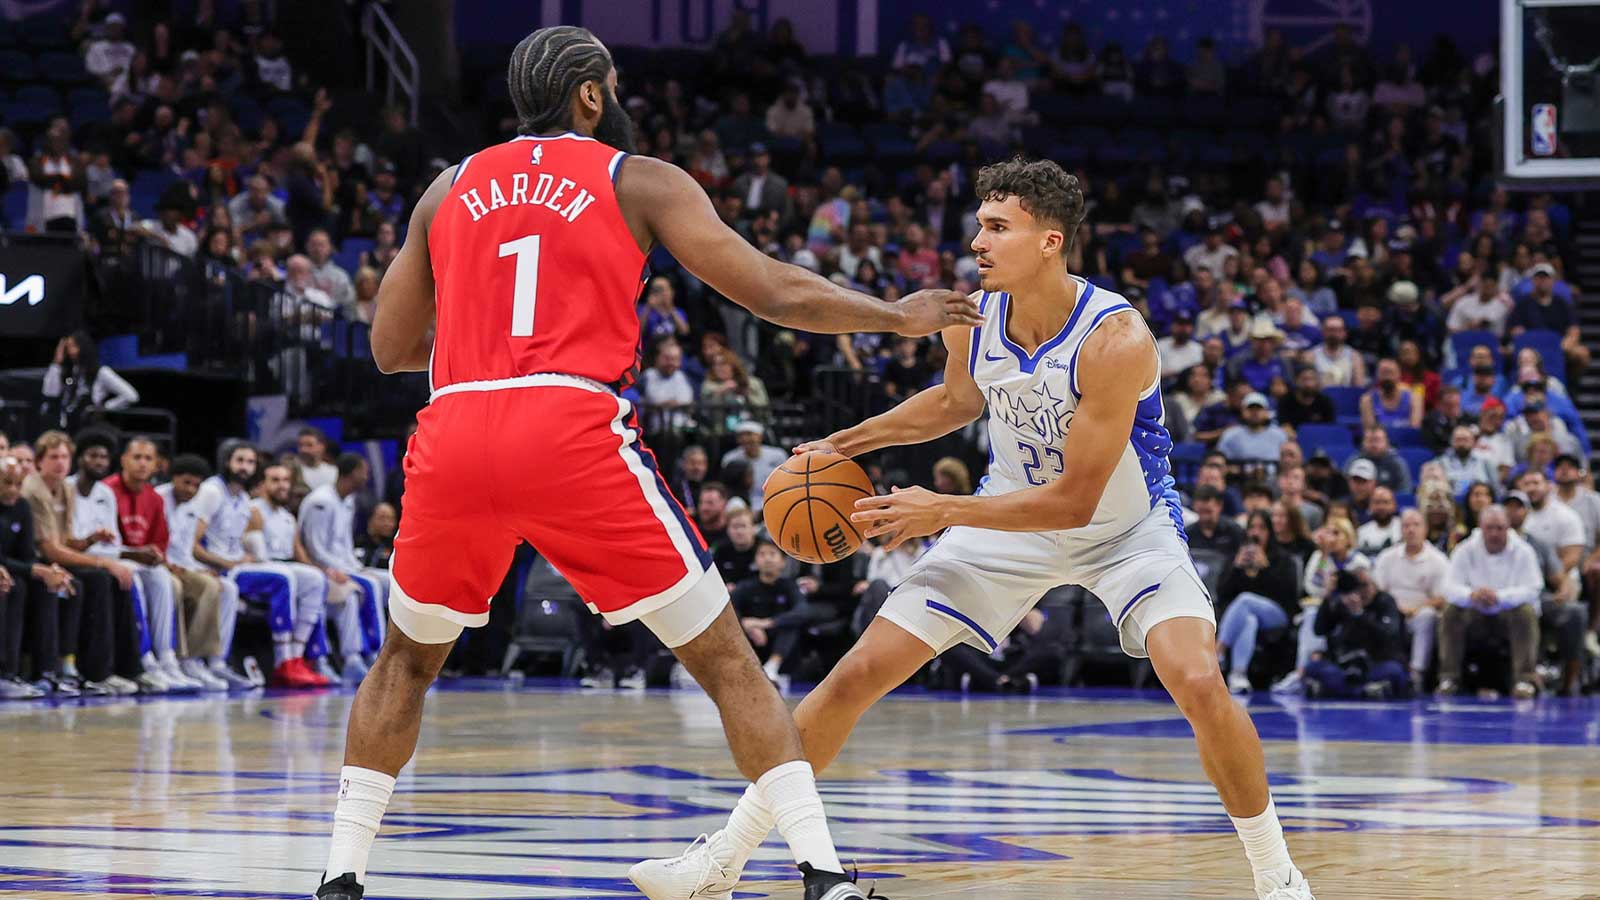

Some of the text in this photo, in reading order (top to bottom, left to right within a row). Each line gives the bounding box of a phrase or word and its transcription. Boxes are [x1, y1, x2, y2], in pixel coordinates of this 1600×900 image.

[459, 172, 596, 223] HARDEN
[498, 234, 541, 337] 1
[1044, 356, 1069, 374] Disney
[1016, 440, 1065, 487] 23
